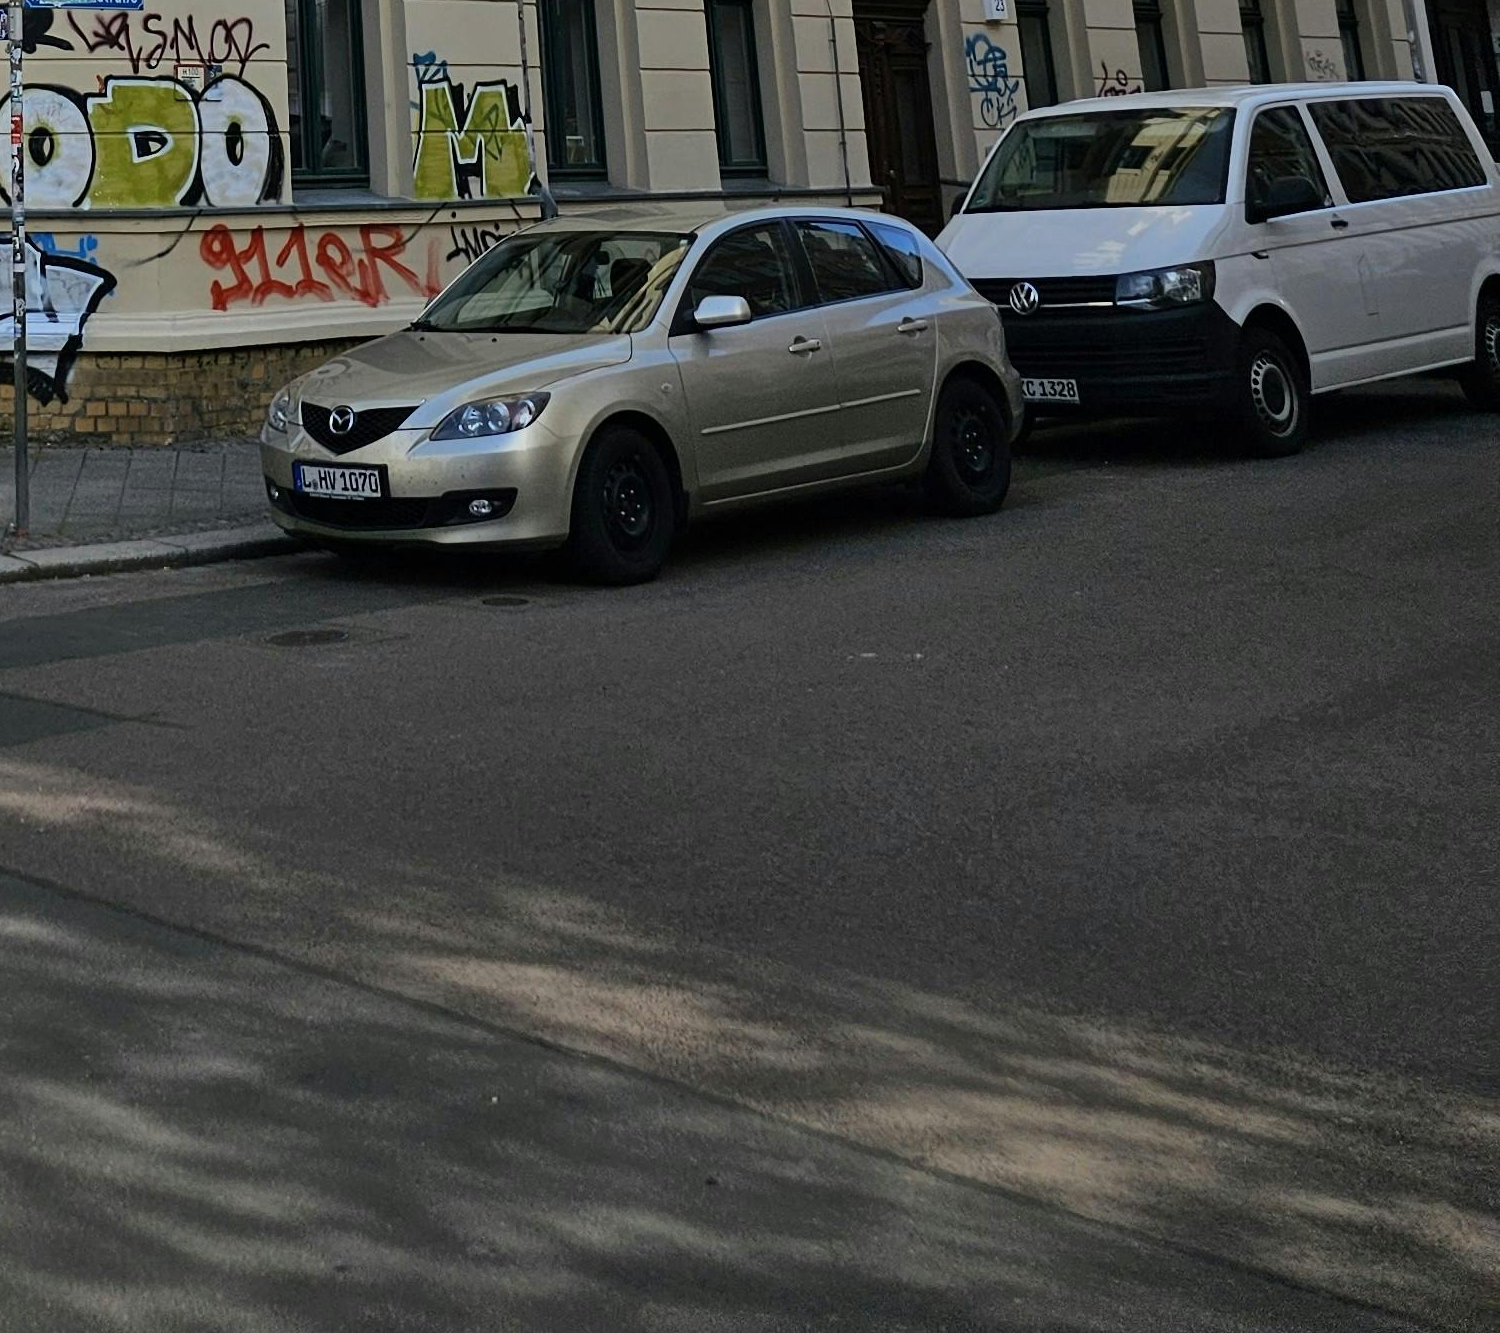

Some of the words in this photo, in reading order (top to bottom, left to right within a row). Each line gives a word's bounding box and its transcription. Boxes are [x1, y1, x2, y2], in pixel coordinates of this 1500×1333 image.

[1039, 381, 1076, 399] 1328
[302, 468, 311, 487] L
[318, 469, 336, 490] HV
[340, 471, 379, 493] 1070
